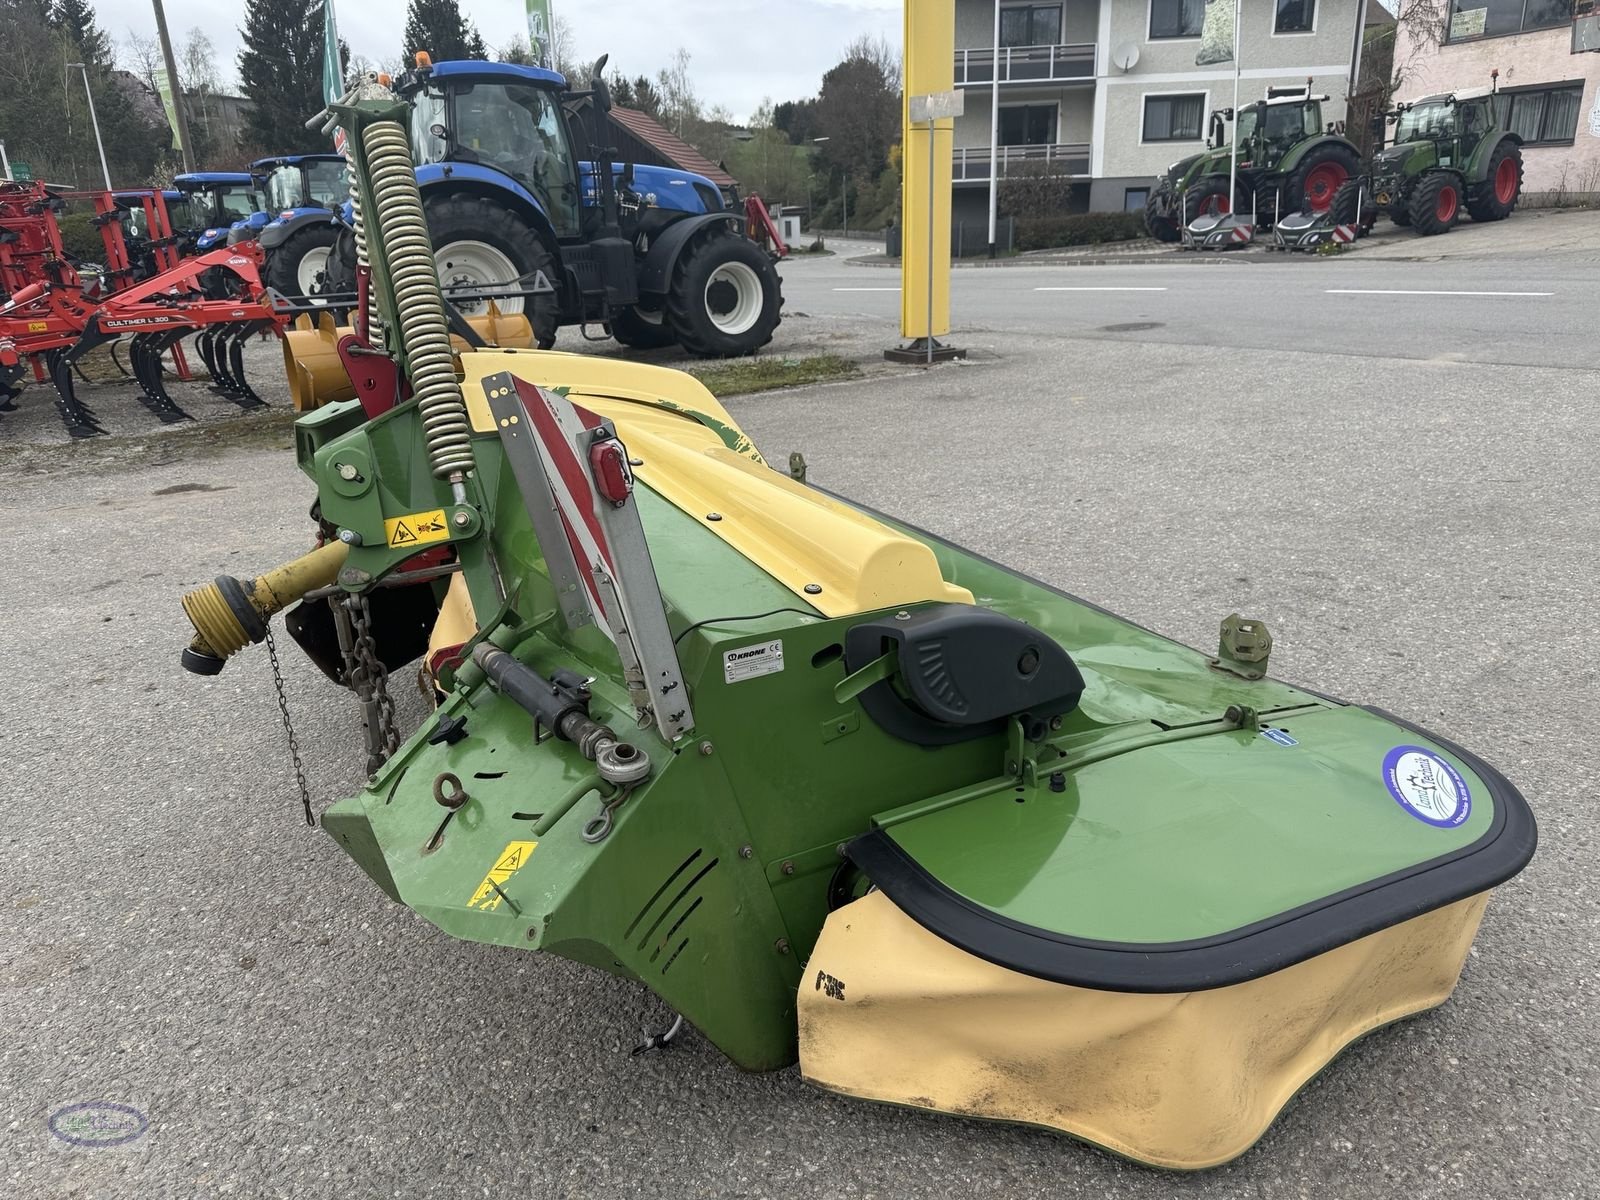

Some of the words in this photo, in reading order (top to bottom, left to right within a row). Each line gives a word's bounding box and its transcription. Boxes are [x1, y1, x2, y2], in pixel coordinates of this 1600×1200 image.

[107, 318, 146, 327] CULTIMER
[737, 648, 766, 660] KRONE
[1413, 757, 1436, 785] Technik
[1411, 787, 1433, 810] Land
